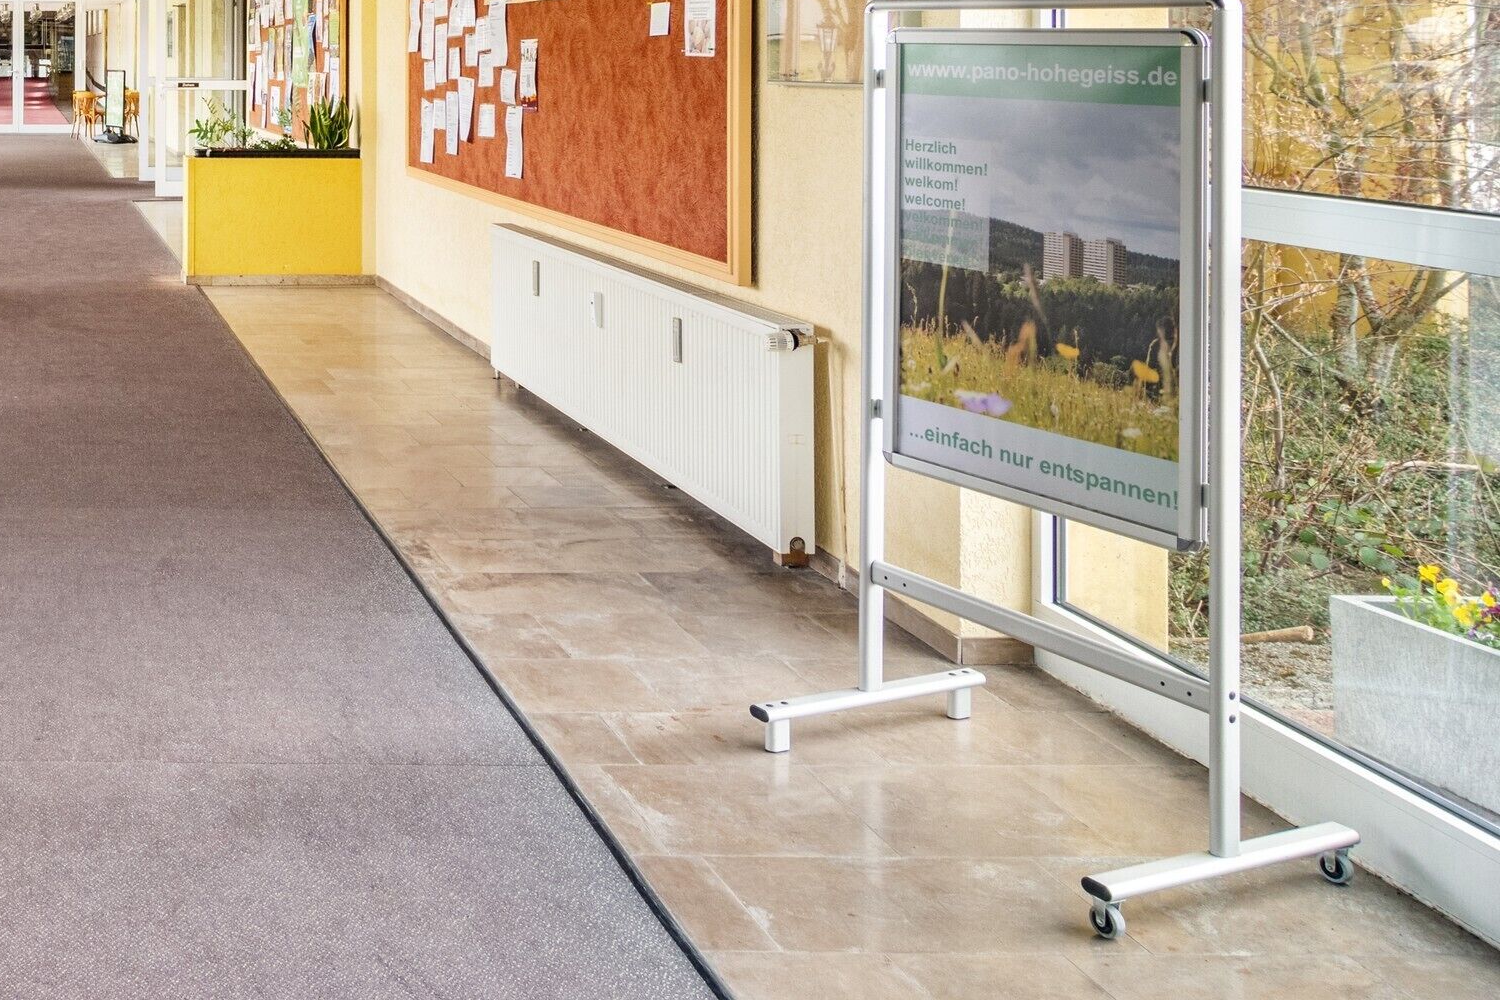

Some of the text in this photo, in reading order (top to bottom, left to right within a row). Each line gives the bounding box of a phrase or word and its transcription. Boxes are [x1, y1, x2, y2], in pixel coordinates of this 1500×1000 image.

[904, 138, 957, 155] Herzlich
[904, 157, 988, 176] willkommen!
[904, 175, 959, 192] welkom!
[904, 193, 966, 211] welcome!
[909, 427, 1179, 511] ...einfach nur entspannen!
